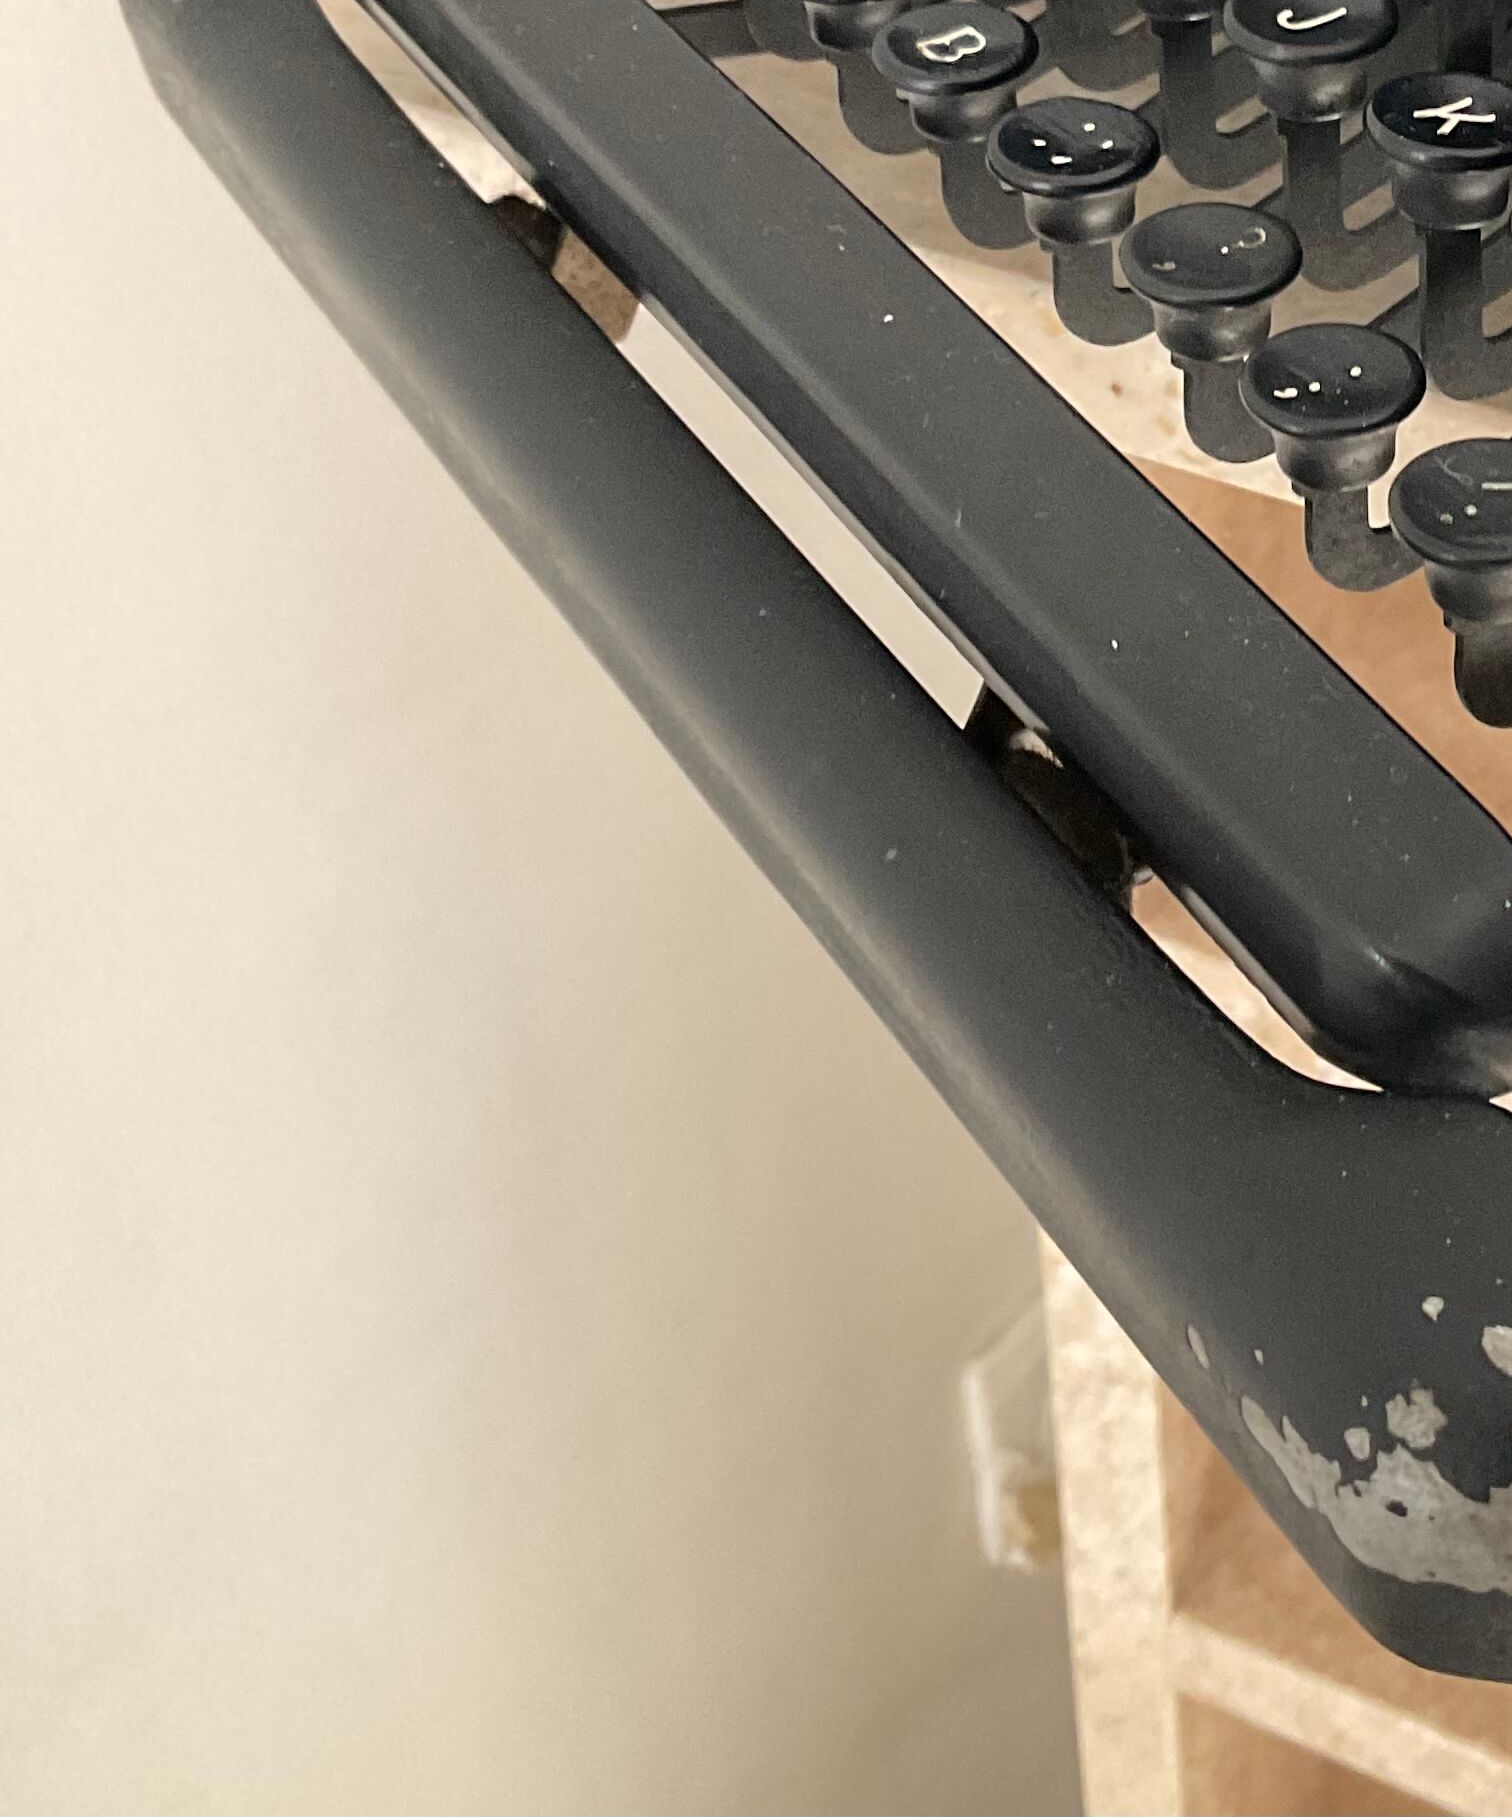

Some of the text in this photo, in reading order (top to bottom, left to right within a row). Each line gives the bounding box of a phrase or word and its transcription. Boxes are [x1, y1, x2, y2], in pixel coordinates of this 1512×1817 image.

[1276, 6, 1348, 31] J
[915, 24, 987, 63] B
[1412, 96, 1497, 136] K
